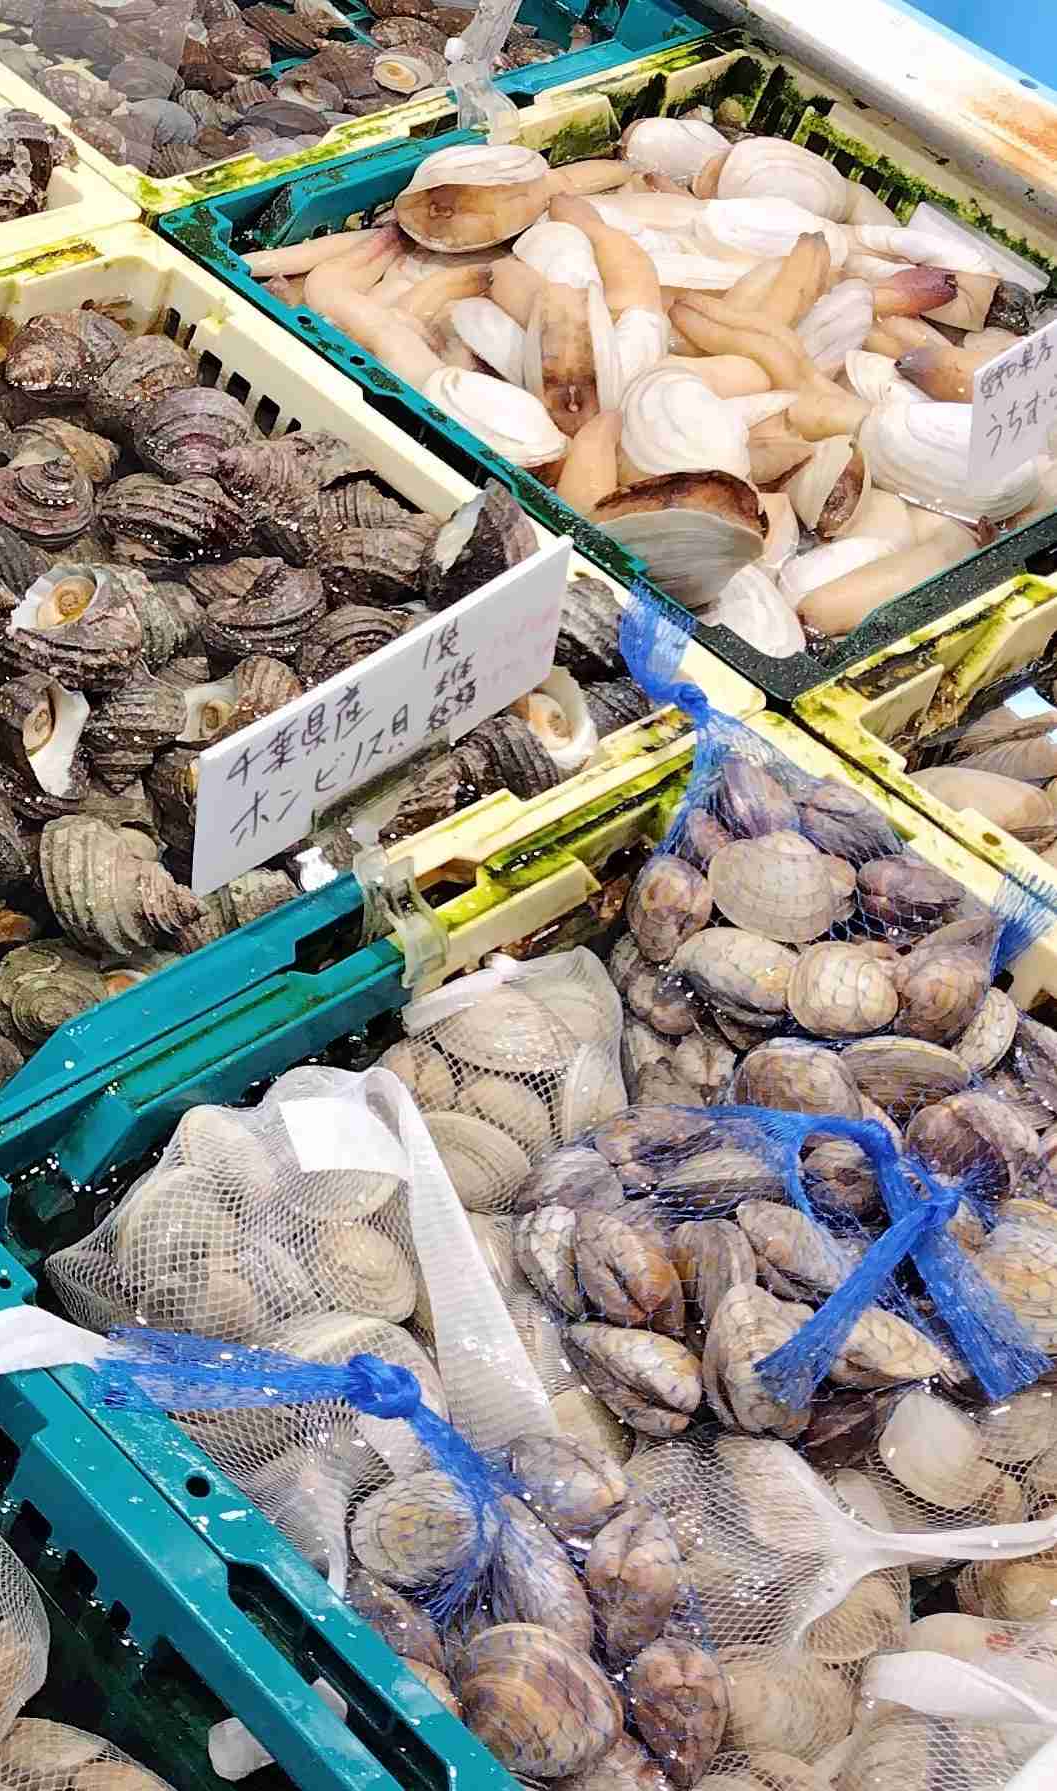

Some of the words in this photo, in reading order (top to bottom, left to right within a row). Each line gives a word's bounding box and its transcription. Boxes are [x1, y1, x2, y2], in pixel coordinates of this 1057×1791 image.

[226, 682, 373, 786] 千葉県産
[229, 703, 409, 847] ホンビノス貝
